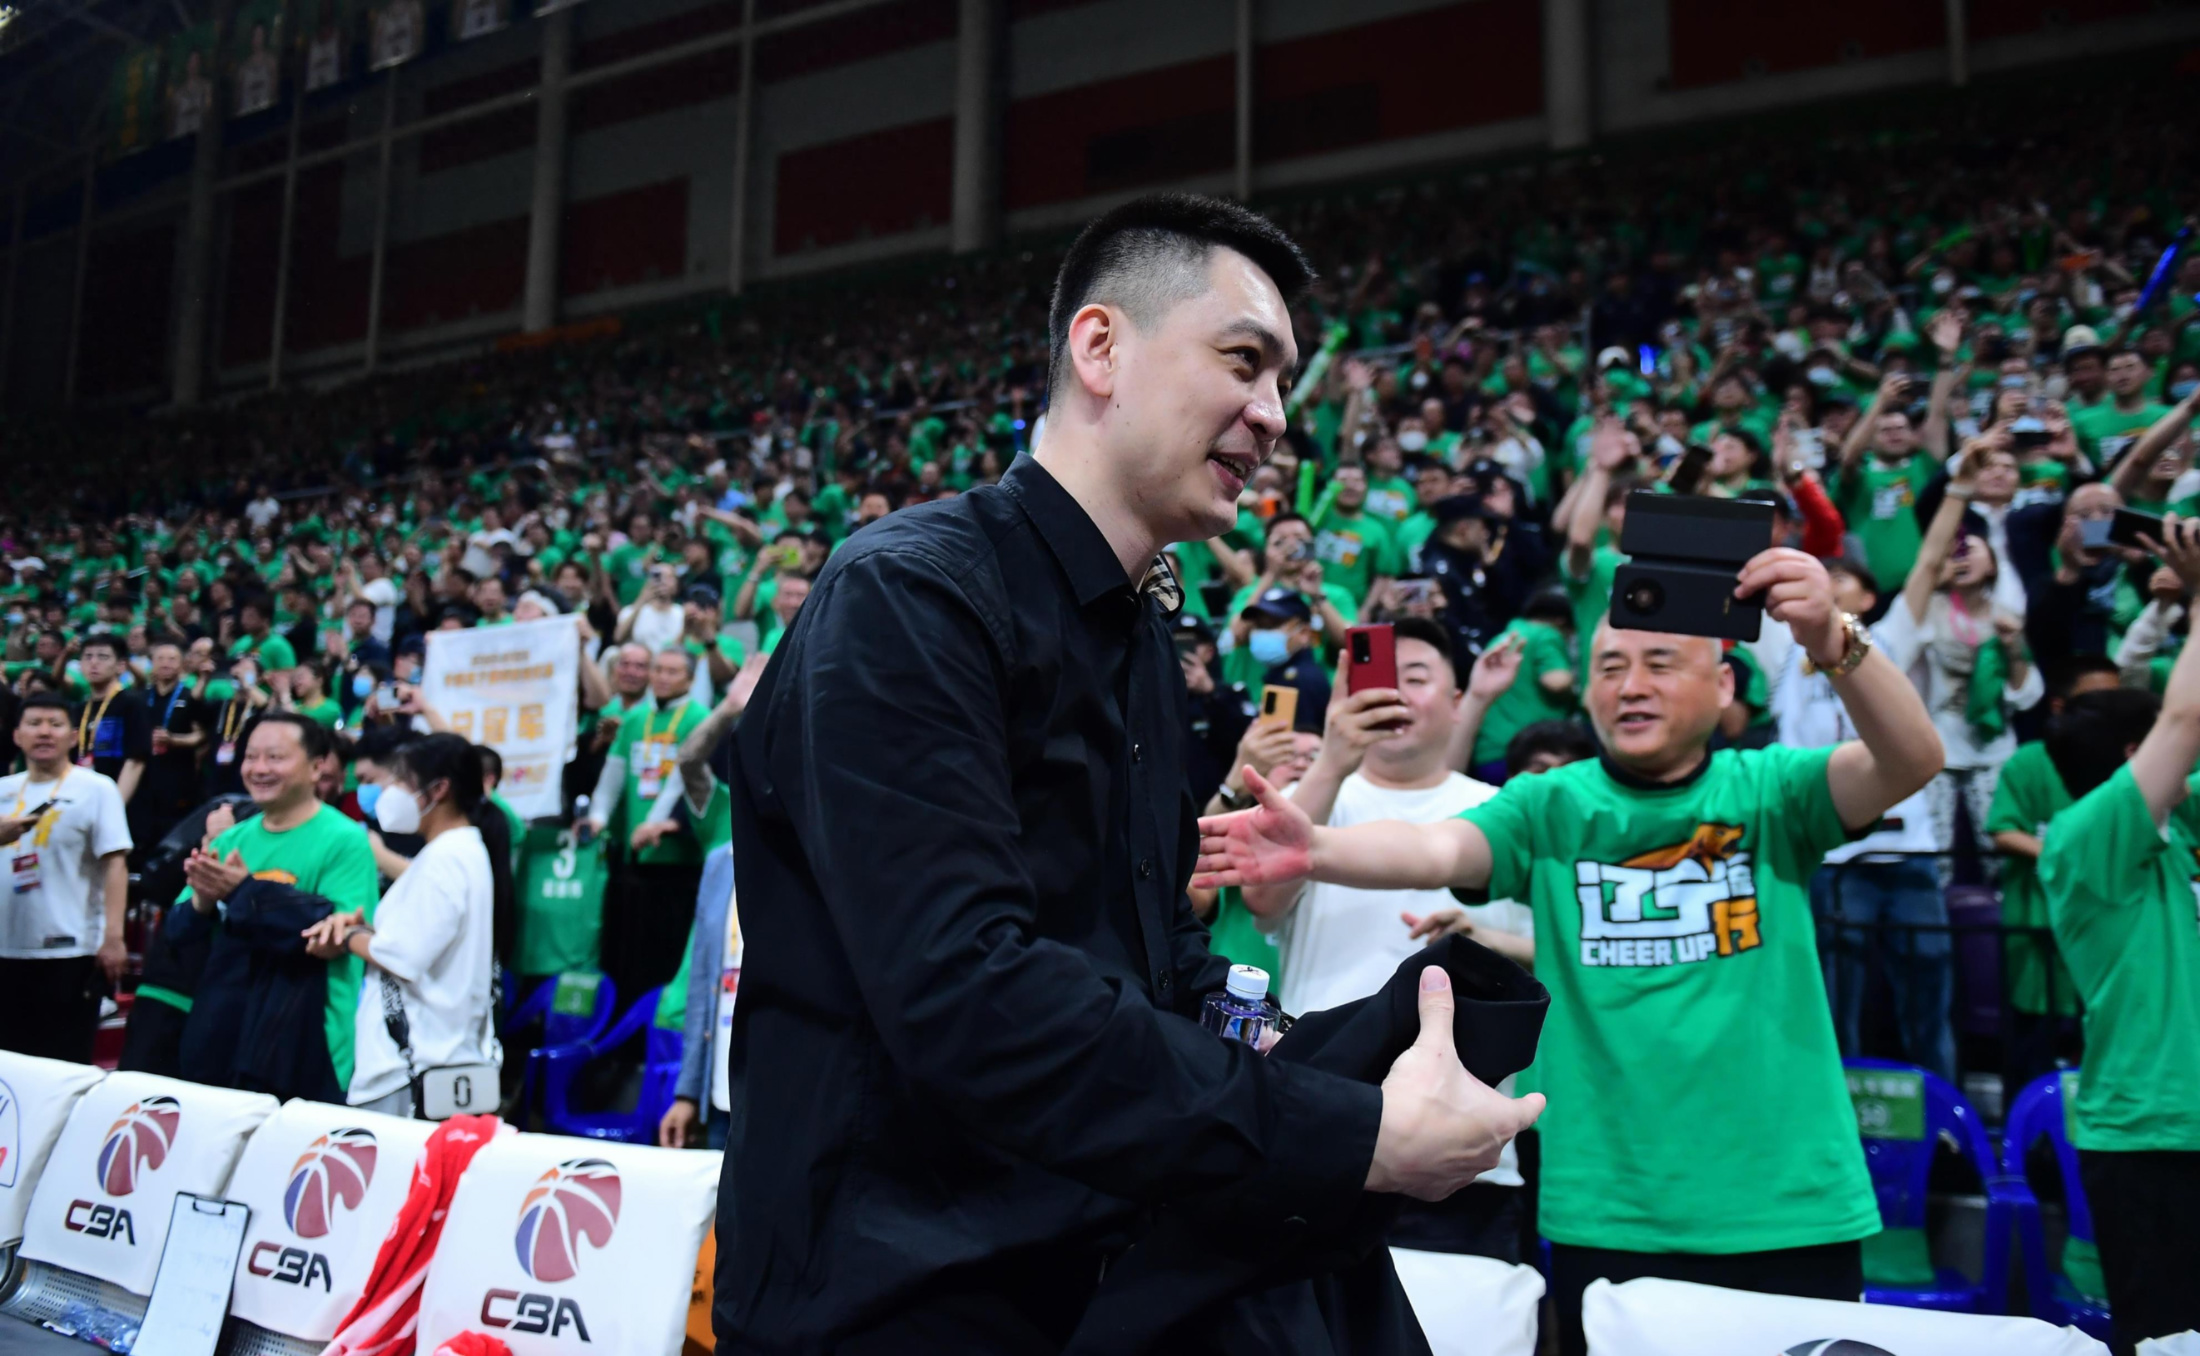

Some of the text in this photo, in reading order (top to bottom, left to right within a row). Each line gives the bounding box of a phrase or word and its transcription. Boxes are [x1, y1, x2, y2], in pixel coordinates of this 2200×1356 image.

[552, 828, 578, 879] 3
[1580, 932, 1717, 967] CHEER UP
[65, 1199, 136, 1246] CBA
[248, 1241, 332, 1294] CBA
[480, 1287, 592, 1343] CBA
